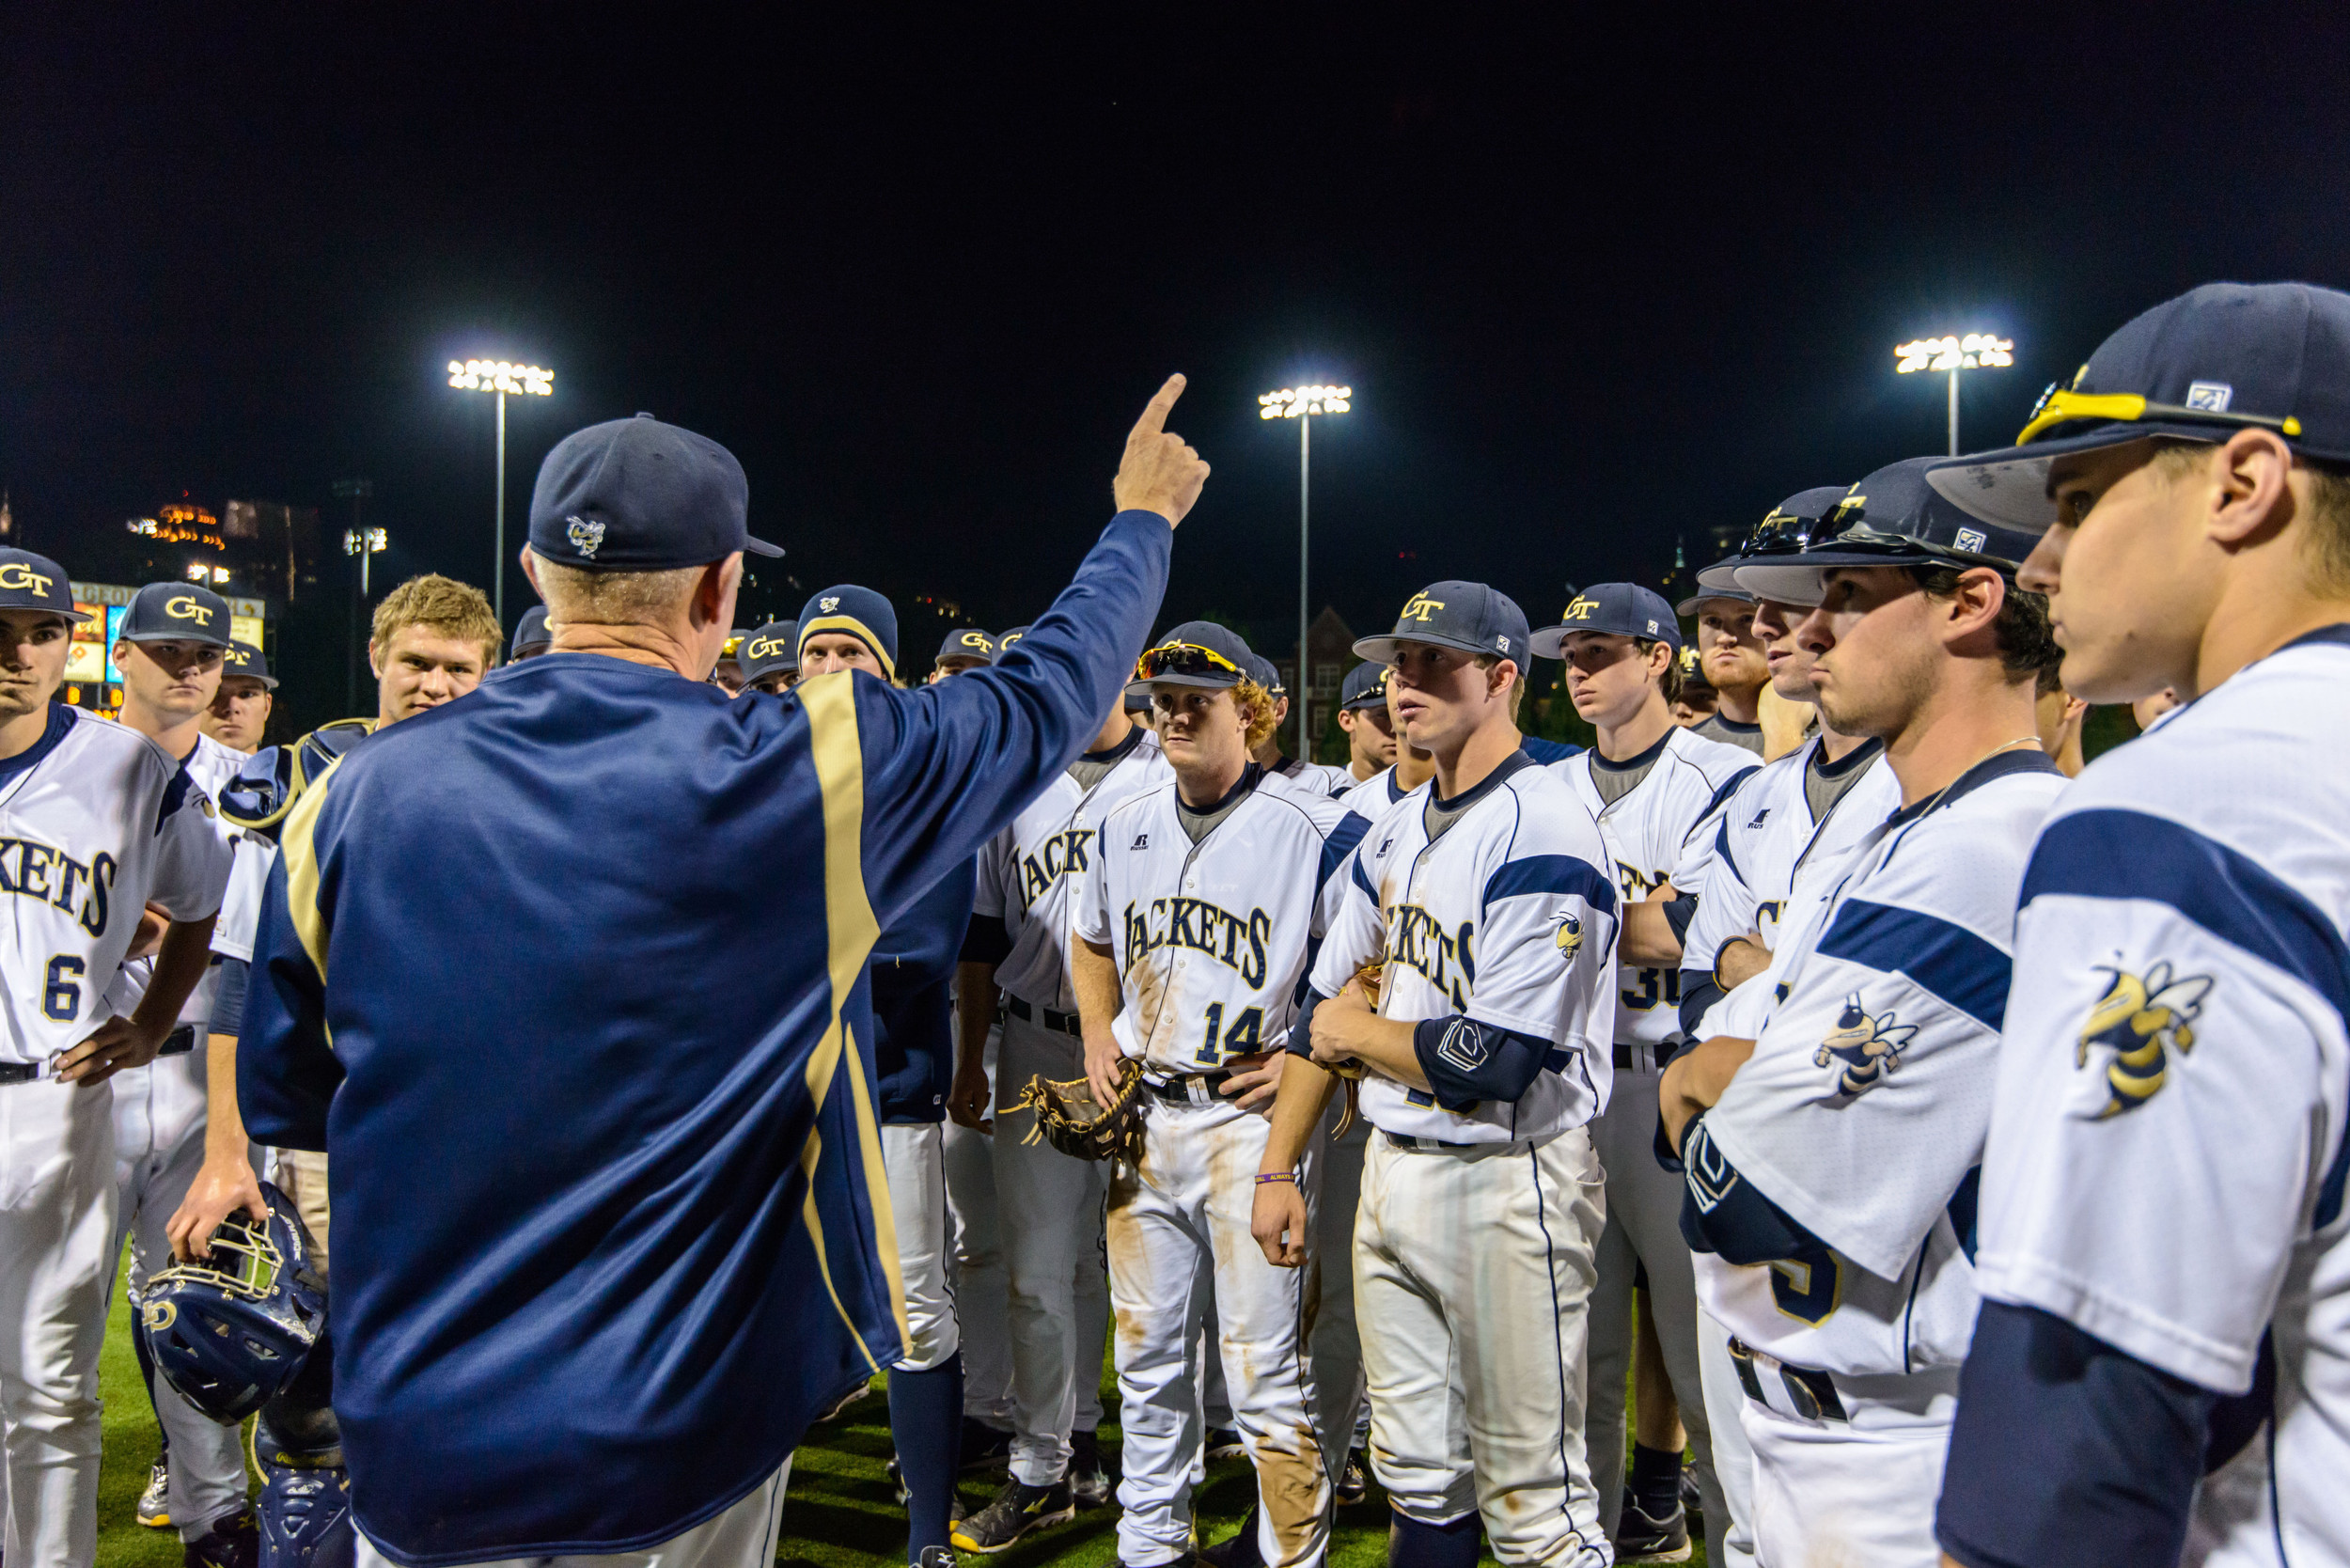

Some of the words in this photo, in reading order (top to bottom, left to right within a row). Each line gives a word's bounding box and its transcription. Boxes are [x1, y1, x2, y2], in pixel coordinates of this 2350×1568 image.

[0, 563, 53, 598] GT
[165, 595, 213, 627] GT
[1401, 590, 1446, 621] GT
[1563, 594, 1600, 620] GT
[748, 635, 784, 660] GT
[961, 632, 994, 654] GT
[1011, 829, 1097, 924] JACK
[1122, 896, 1272, 991] JACKETS
[40, 953, 86, 1023] 6
[1194, 1000, 1265, 1067] 14
